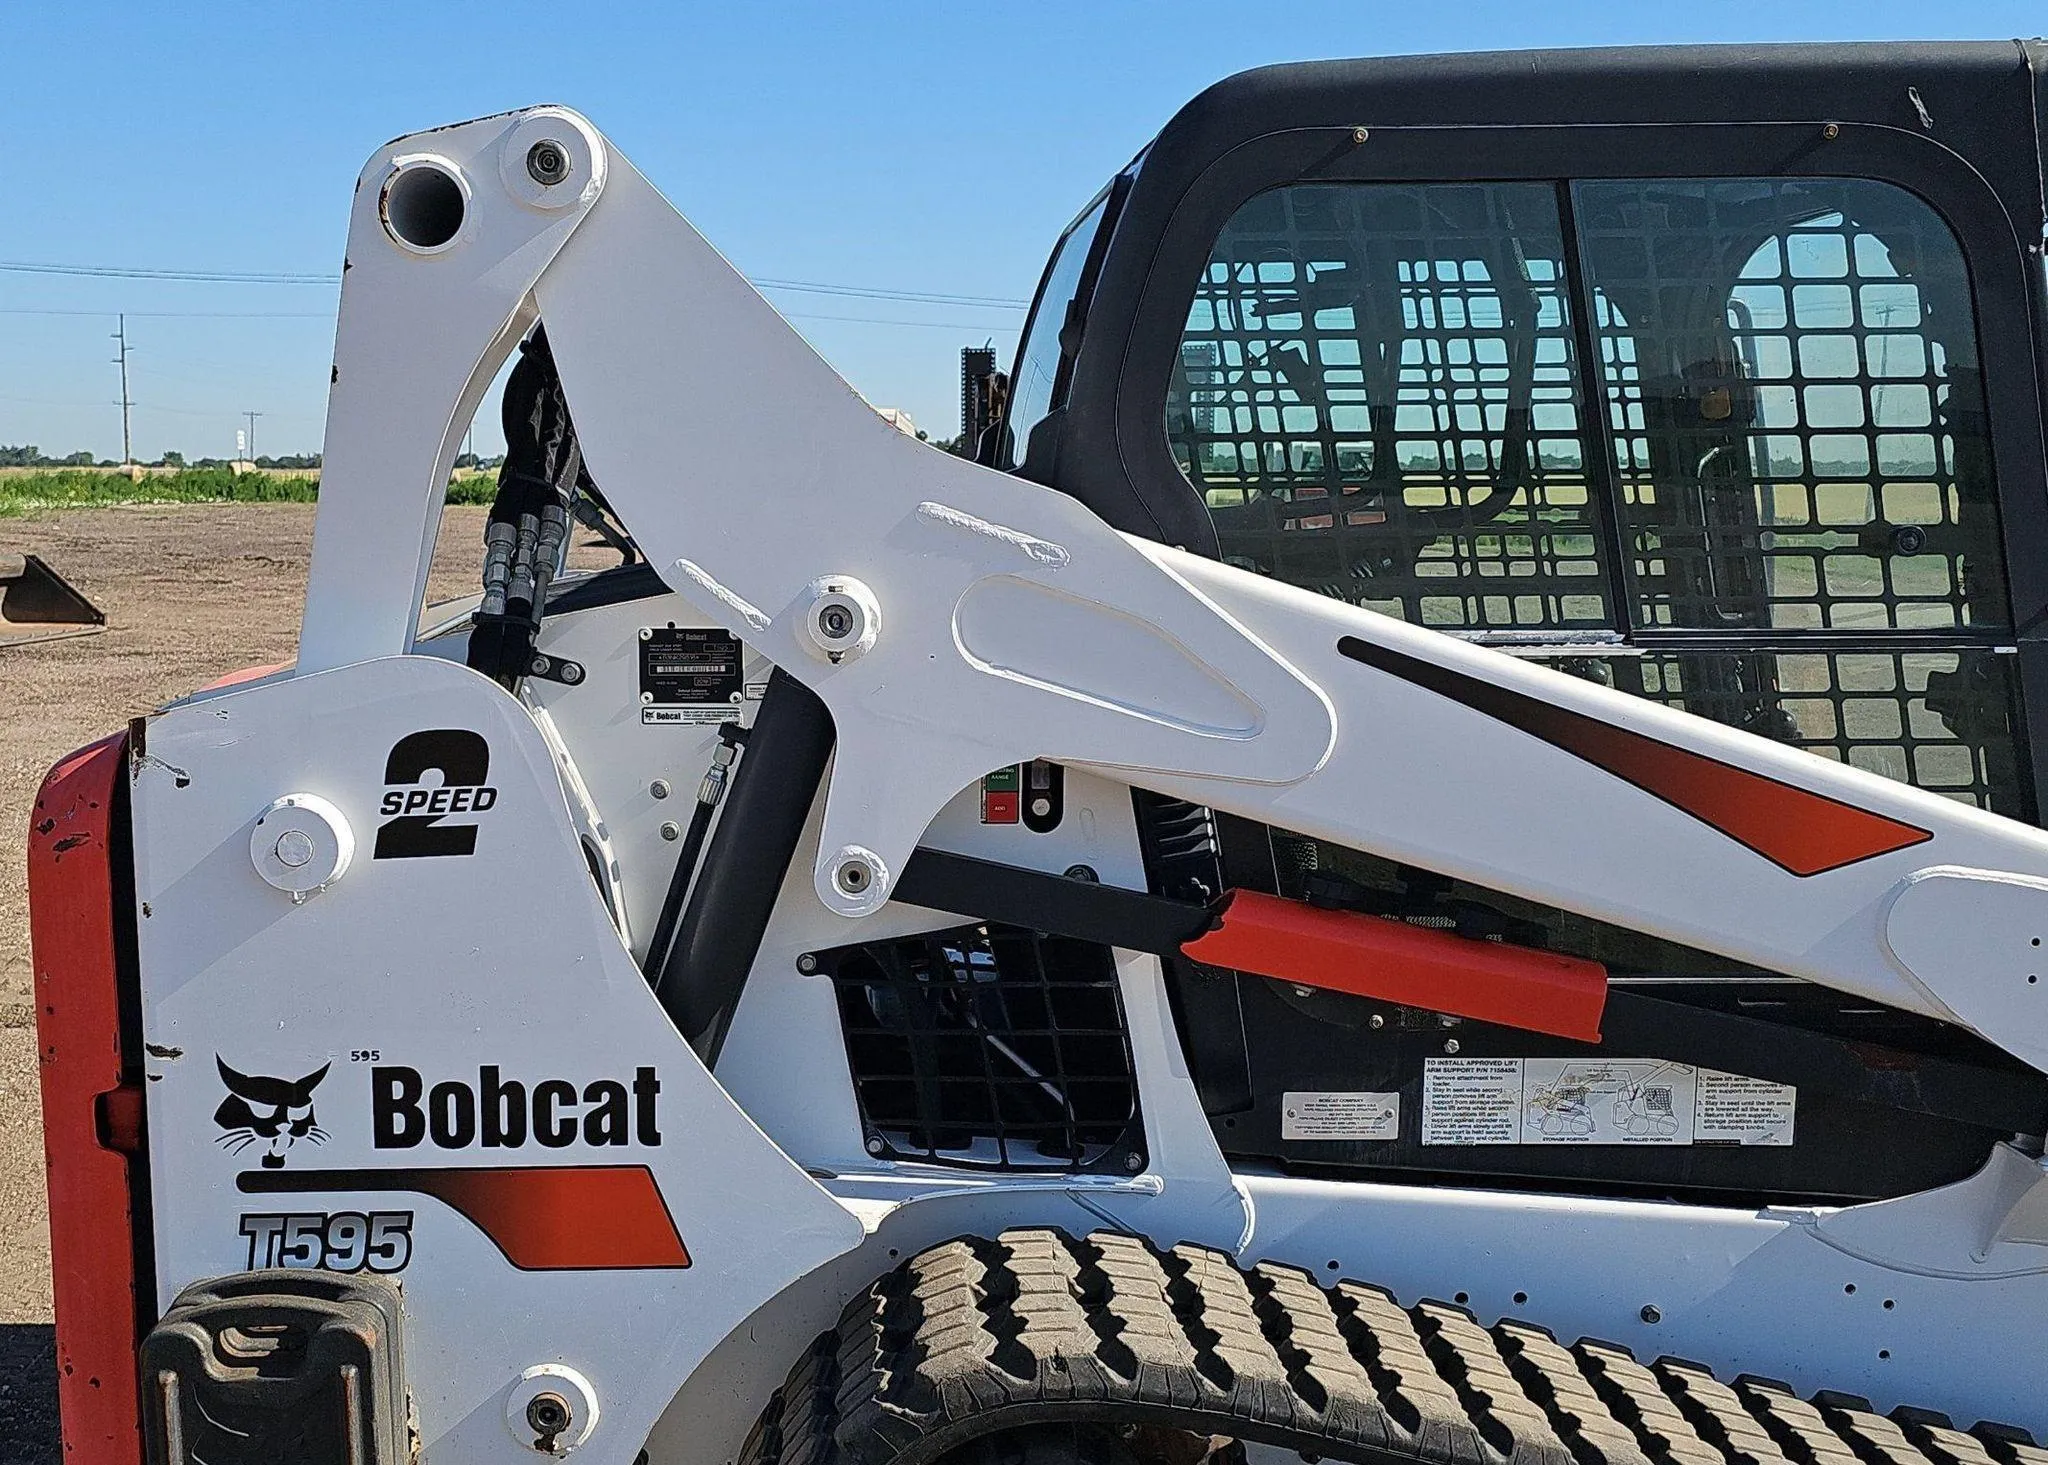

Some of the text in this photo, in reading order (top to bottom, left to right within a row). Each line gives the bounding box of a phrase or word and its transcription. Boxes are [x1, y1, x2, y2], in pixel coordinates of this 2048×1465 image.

[656, 712, 680, 720] Bobcat
[373, 729, 489, 859] 2
[380, 787, 497, 815] SPEED
[351, 1050, 380, 1061] 595
[372, 1066, 662, 1149] Bobcat
[239, 1211, 414, 1274] T595
